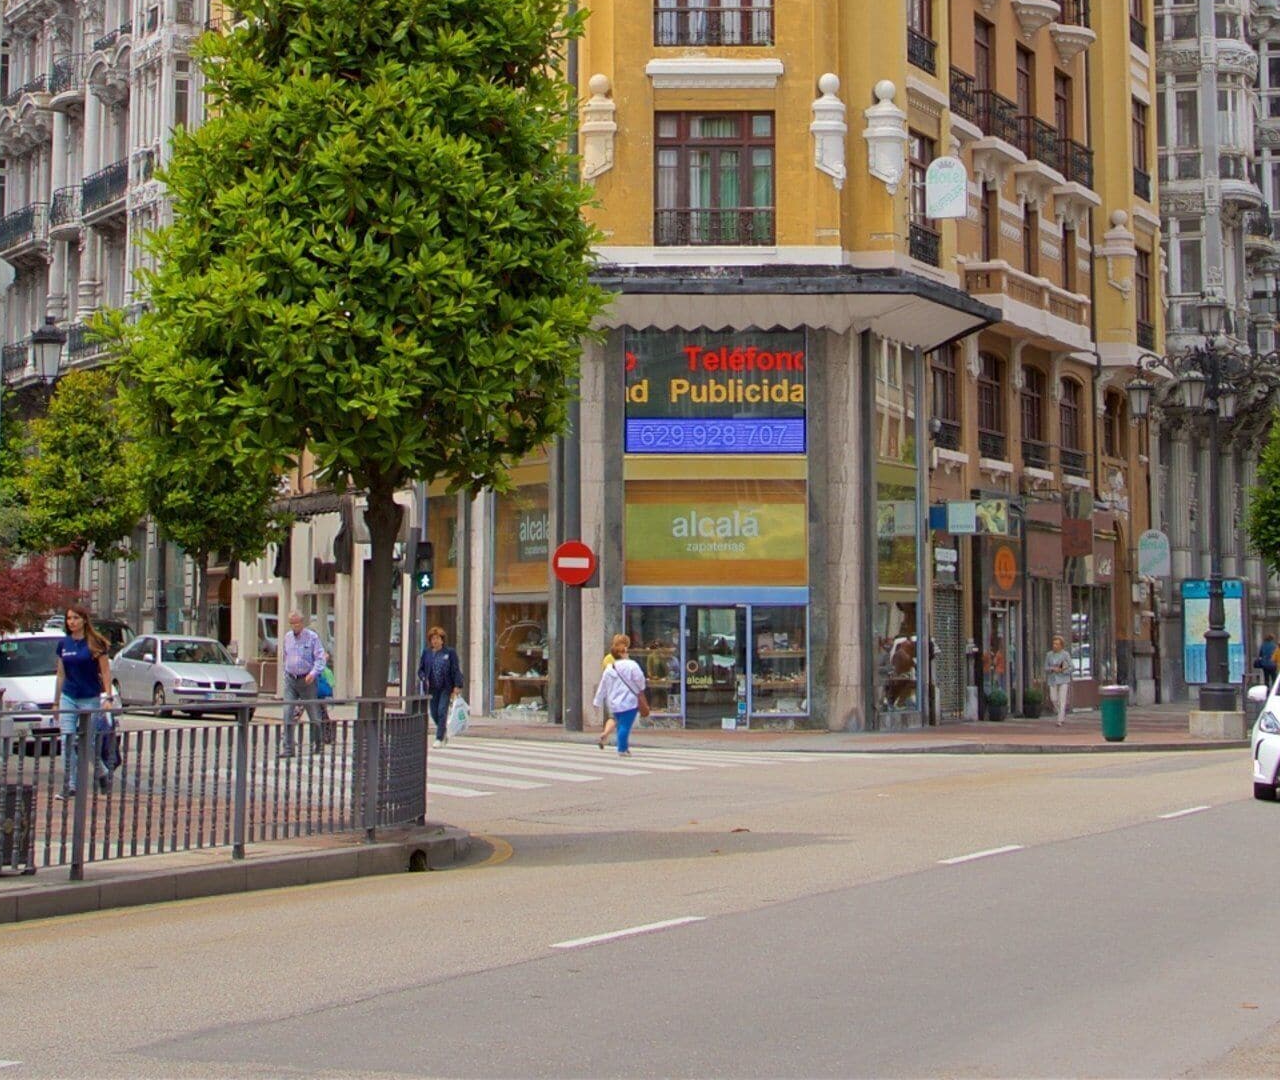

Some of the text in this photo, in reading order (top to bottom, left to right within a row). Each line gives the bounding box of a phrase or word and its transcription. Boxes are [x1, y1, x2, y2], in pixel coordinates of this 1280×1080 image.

[670, 378, 804, 403] Publicida
[640, 425, 787, 446] 629 928 707
